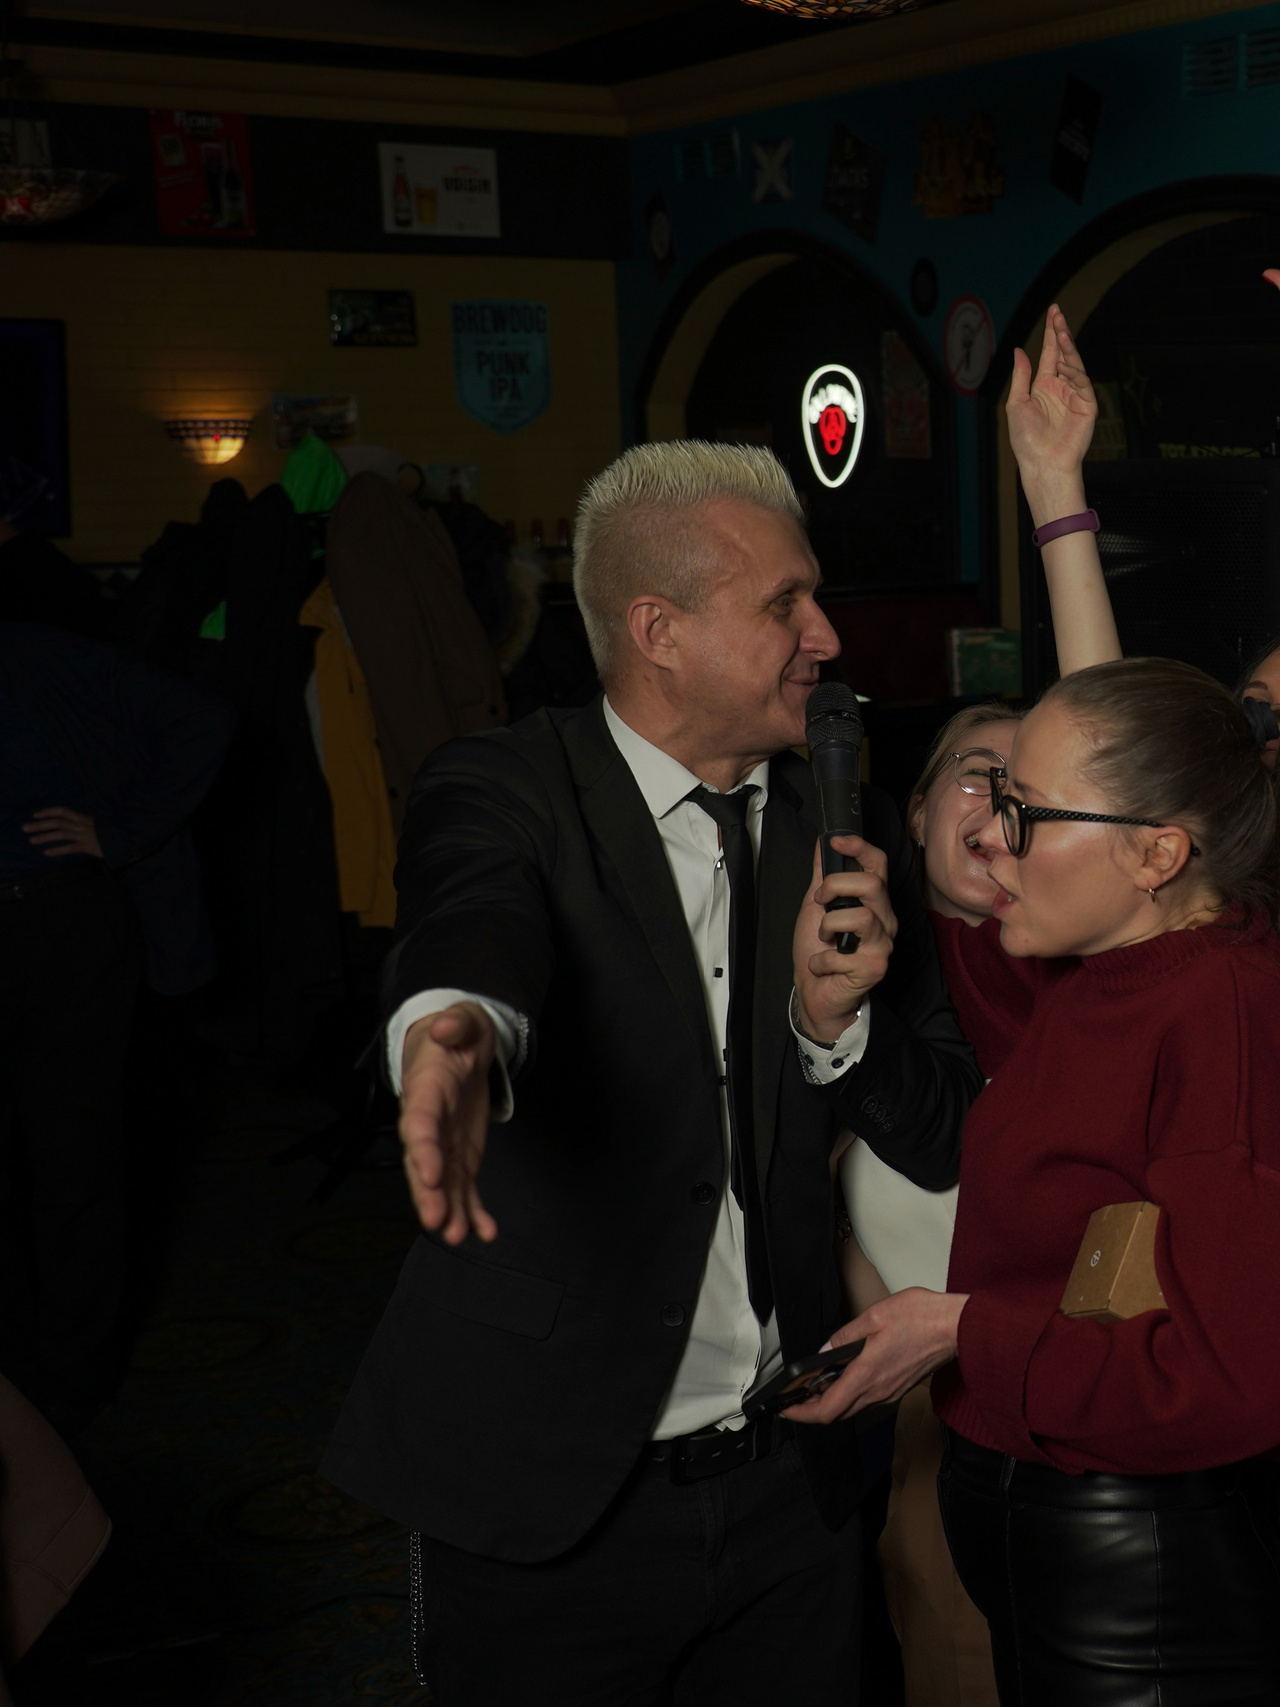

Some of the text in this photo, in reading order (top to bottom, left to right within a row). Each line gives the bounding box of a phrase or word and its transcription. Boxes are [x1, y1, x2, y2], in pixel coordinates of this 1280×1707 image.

[452, 303, 548, 334] BREWDOG
[476, 350, 531, 375] PUNK
[489, 377, 523, 401] IPA
